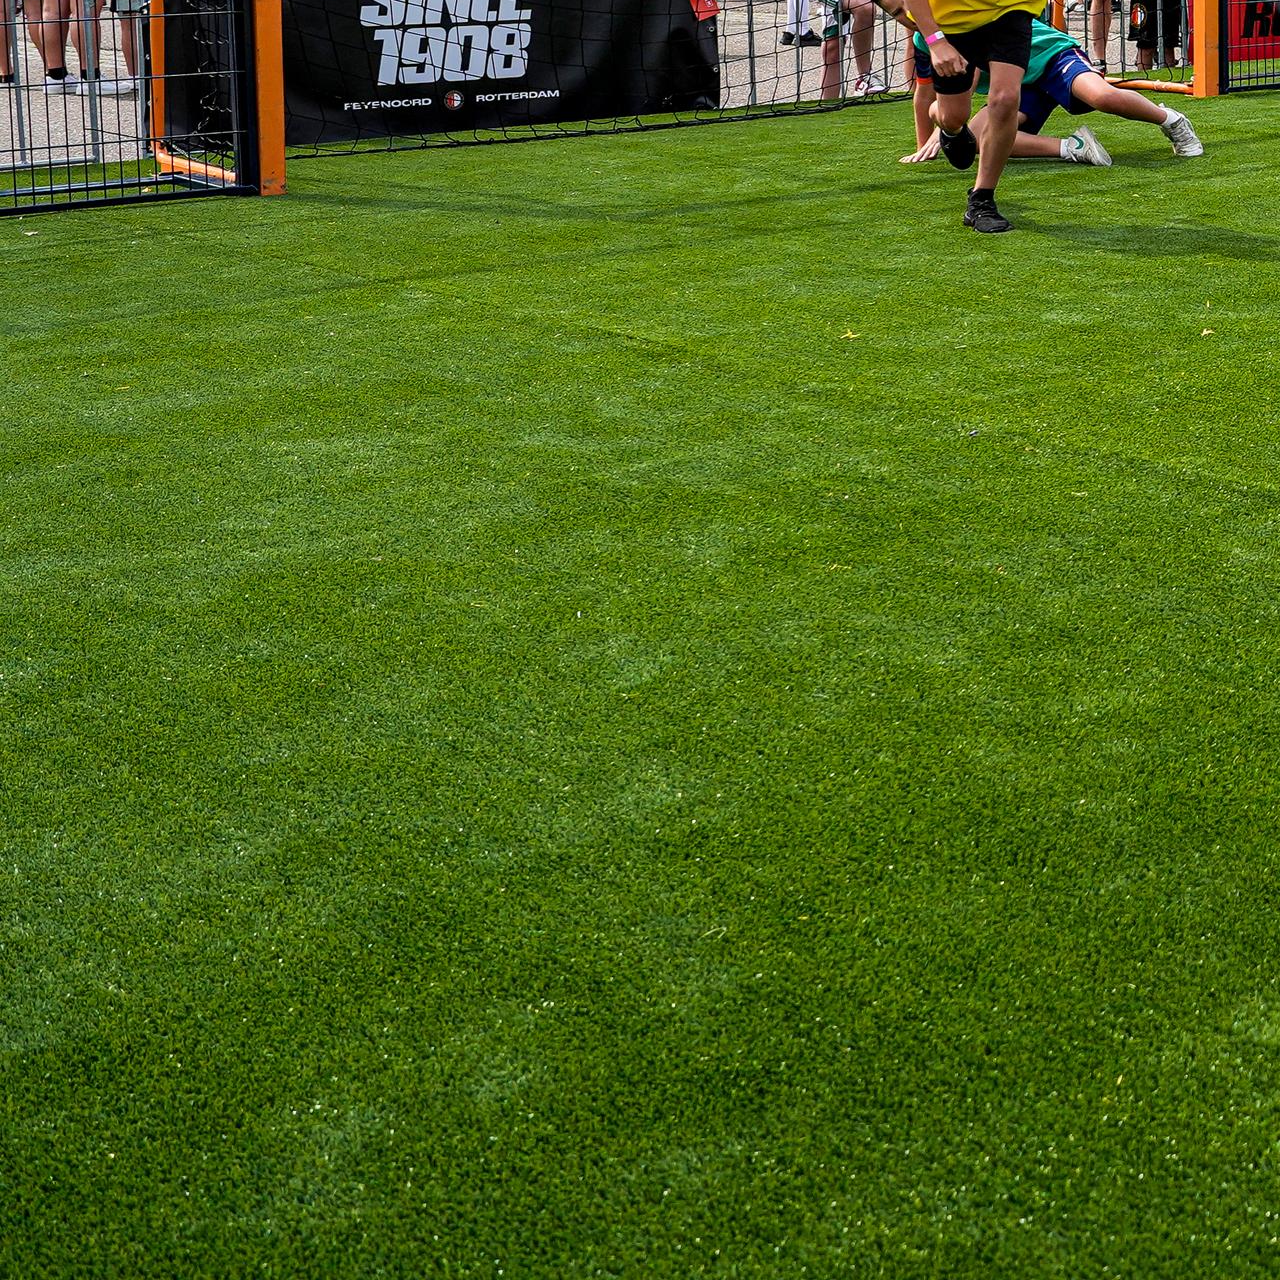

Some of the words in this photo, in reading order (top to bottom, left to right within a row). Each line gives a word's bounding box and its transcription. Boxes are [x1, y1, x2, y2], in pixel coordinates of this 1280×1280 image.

[374, 23, 531, 85] 1908
[343, 97, 432, 110] FEYENOORD
[475, 89, 560, 102] ROTTERDAM
